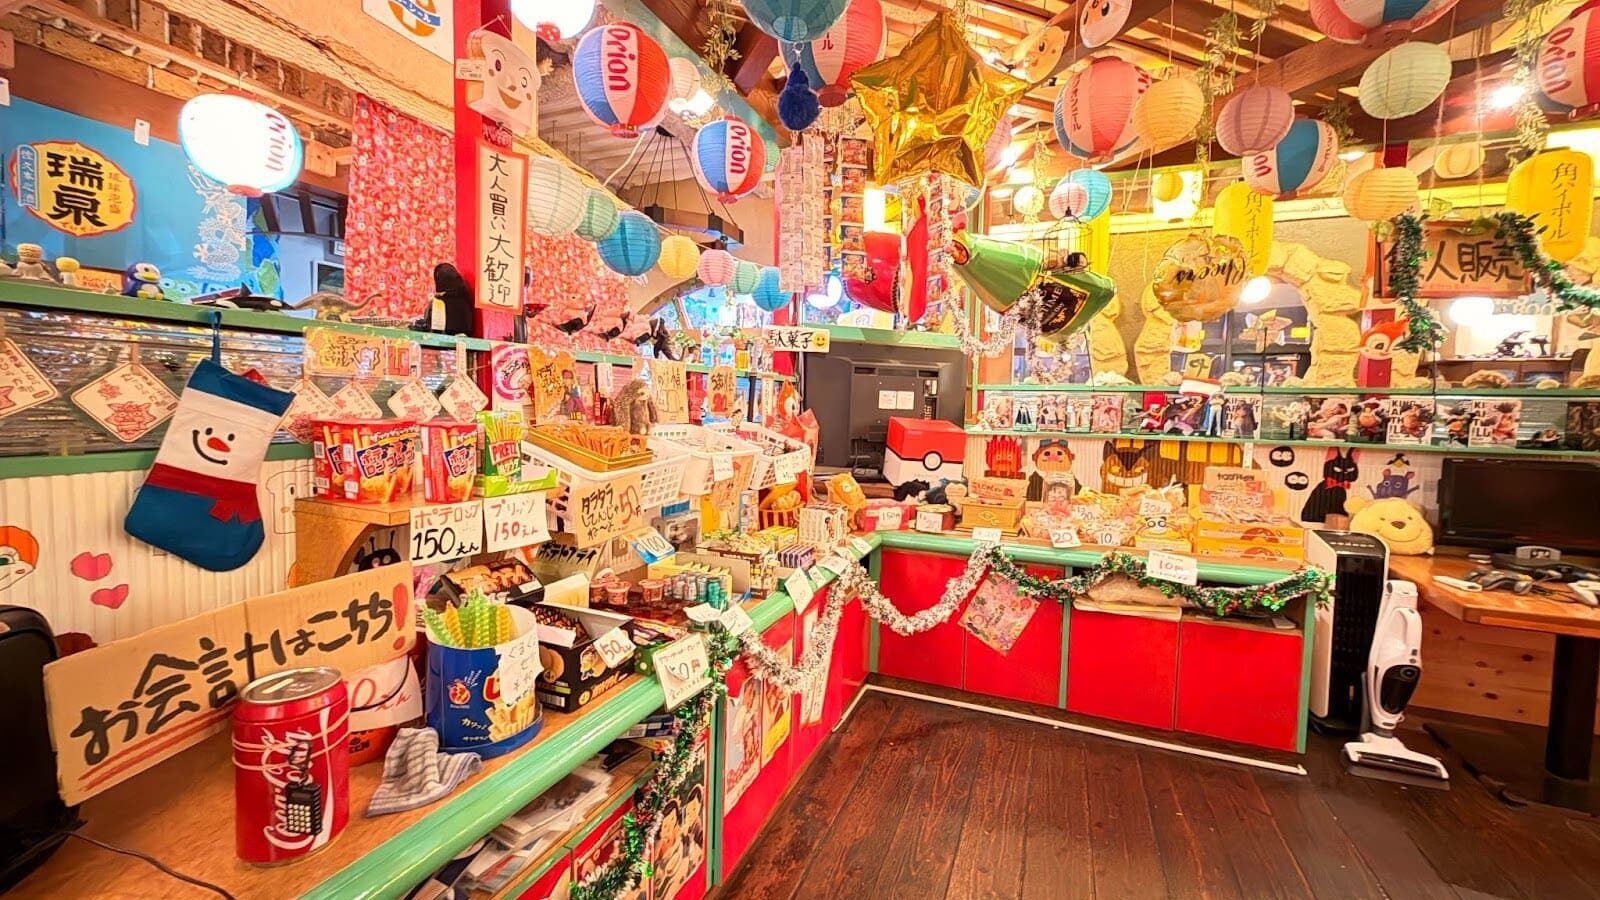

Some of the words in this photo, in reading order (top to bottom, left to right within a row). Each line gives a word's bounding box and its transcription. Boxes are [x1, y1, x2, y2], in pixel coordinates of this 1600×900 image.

[605, 27, 636, 92] Orion
[1542, 27, 1577, 94] Orion
[265, 112, 293, 171] Orion
[730, 124, 752, 175] Orion
[1551, 162, 1578, 241] 角ハイボール
[484, 152, 515, 308] 大人買い大歓迎
[1175, 257, 1247, 287] Cheers
[1384, 240, 1526, 284] 人販売
[768, 329, 814, 350] 駄菓子
[414, 504, 480, 529] ポテロング
[491, 499, 535, 517] プリッツ
[412, 527, 480, 561] 150えん
[493, 521, 538, 542] 150えん
[538, 542, 597, 567] ポテトフライ
[262, 726, 314, 850] Coca-Cola
